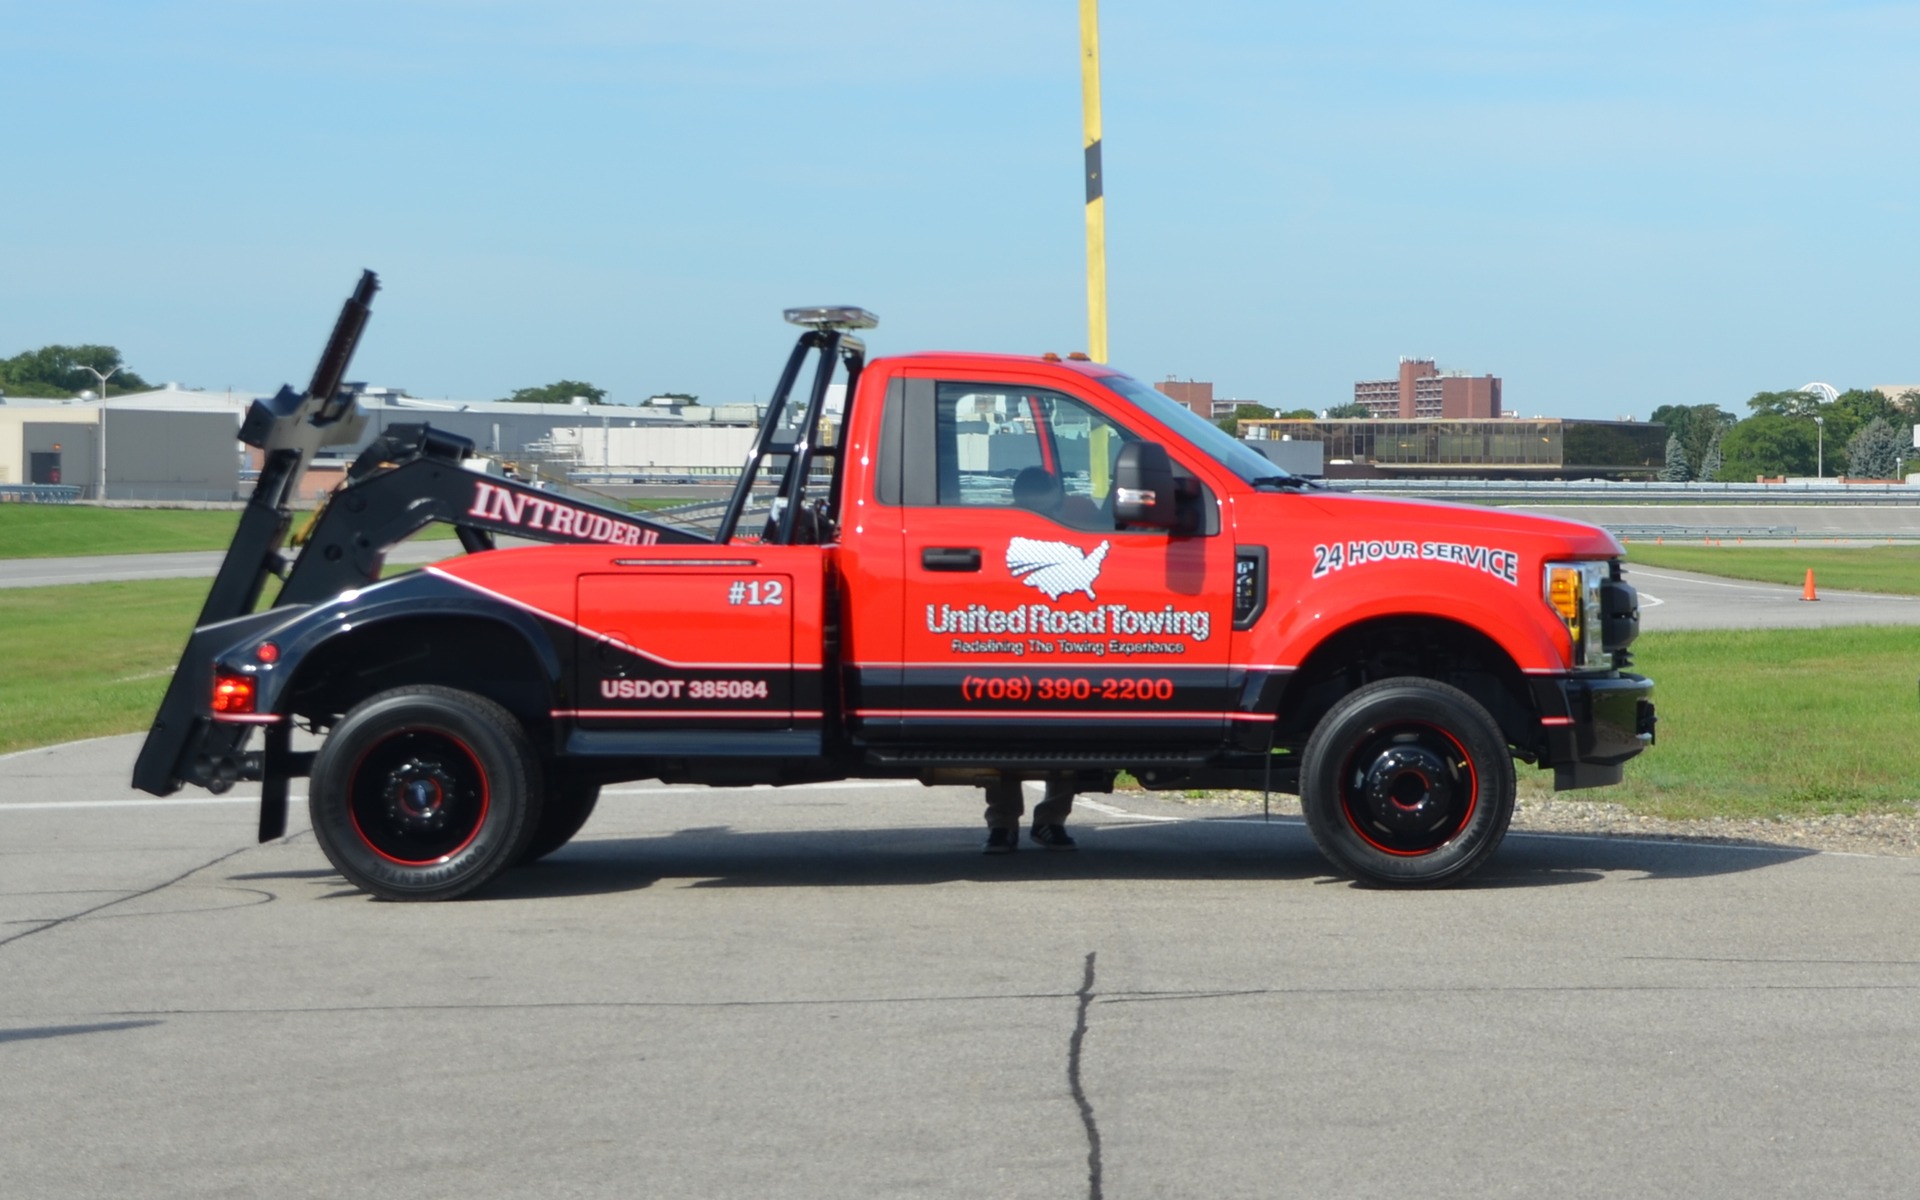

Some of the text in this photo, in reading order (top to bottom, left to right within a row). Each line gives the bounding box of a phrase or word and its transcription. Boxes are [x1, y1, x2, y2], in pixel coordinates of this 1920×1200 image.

[468, 481, 641, 545] INTRUDER
[1312, 540, 1518, 586] 24 HOUR SERVICE
[728, 580, 784, 606] #12
[1028, 638, 1054, 653] The
[1057, 638, 1105, 656] Towing
[1108, 639, 1185, 656] Experience
[600, 679, 769, 699] USDOT 385084
[961, 675, 1174, 701] (708) 390-2200
